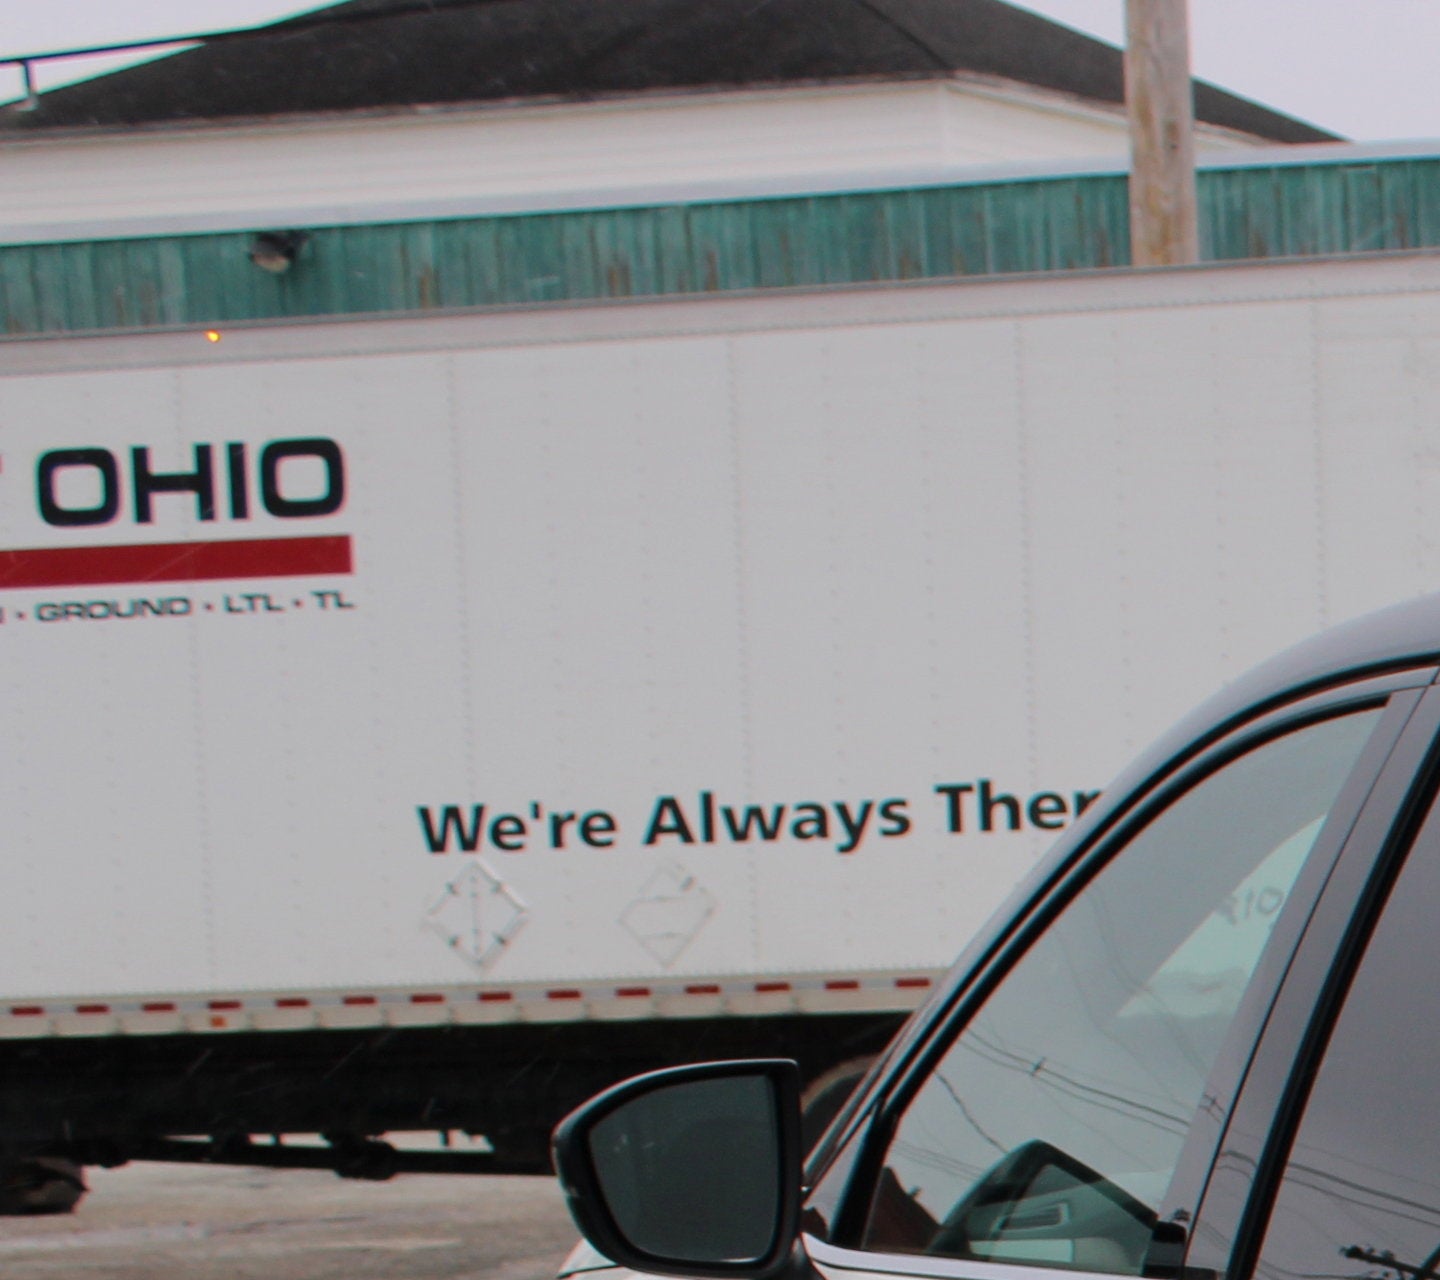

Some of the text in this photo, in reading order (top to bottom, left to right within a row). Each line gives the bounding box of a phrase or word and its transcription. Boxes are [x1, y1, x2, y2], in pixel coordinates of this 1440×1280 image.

[35, 436, 349, 528] OHIO
[35, 589, 356, 623] GROUND LTL TL
[416, 778, 1105, 854] We're Always Ther
